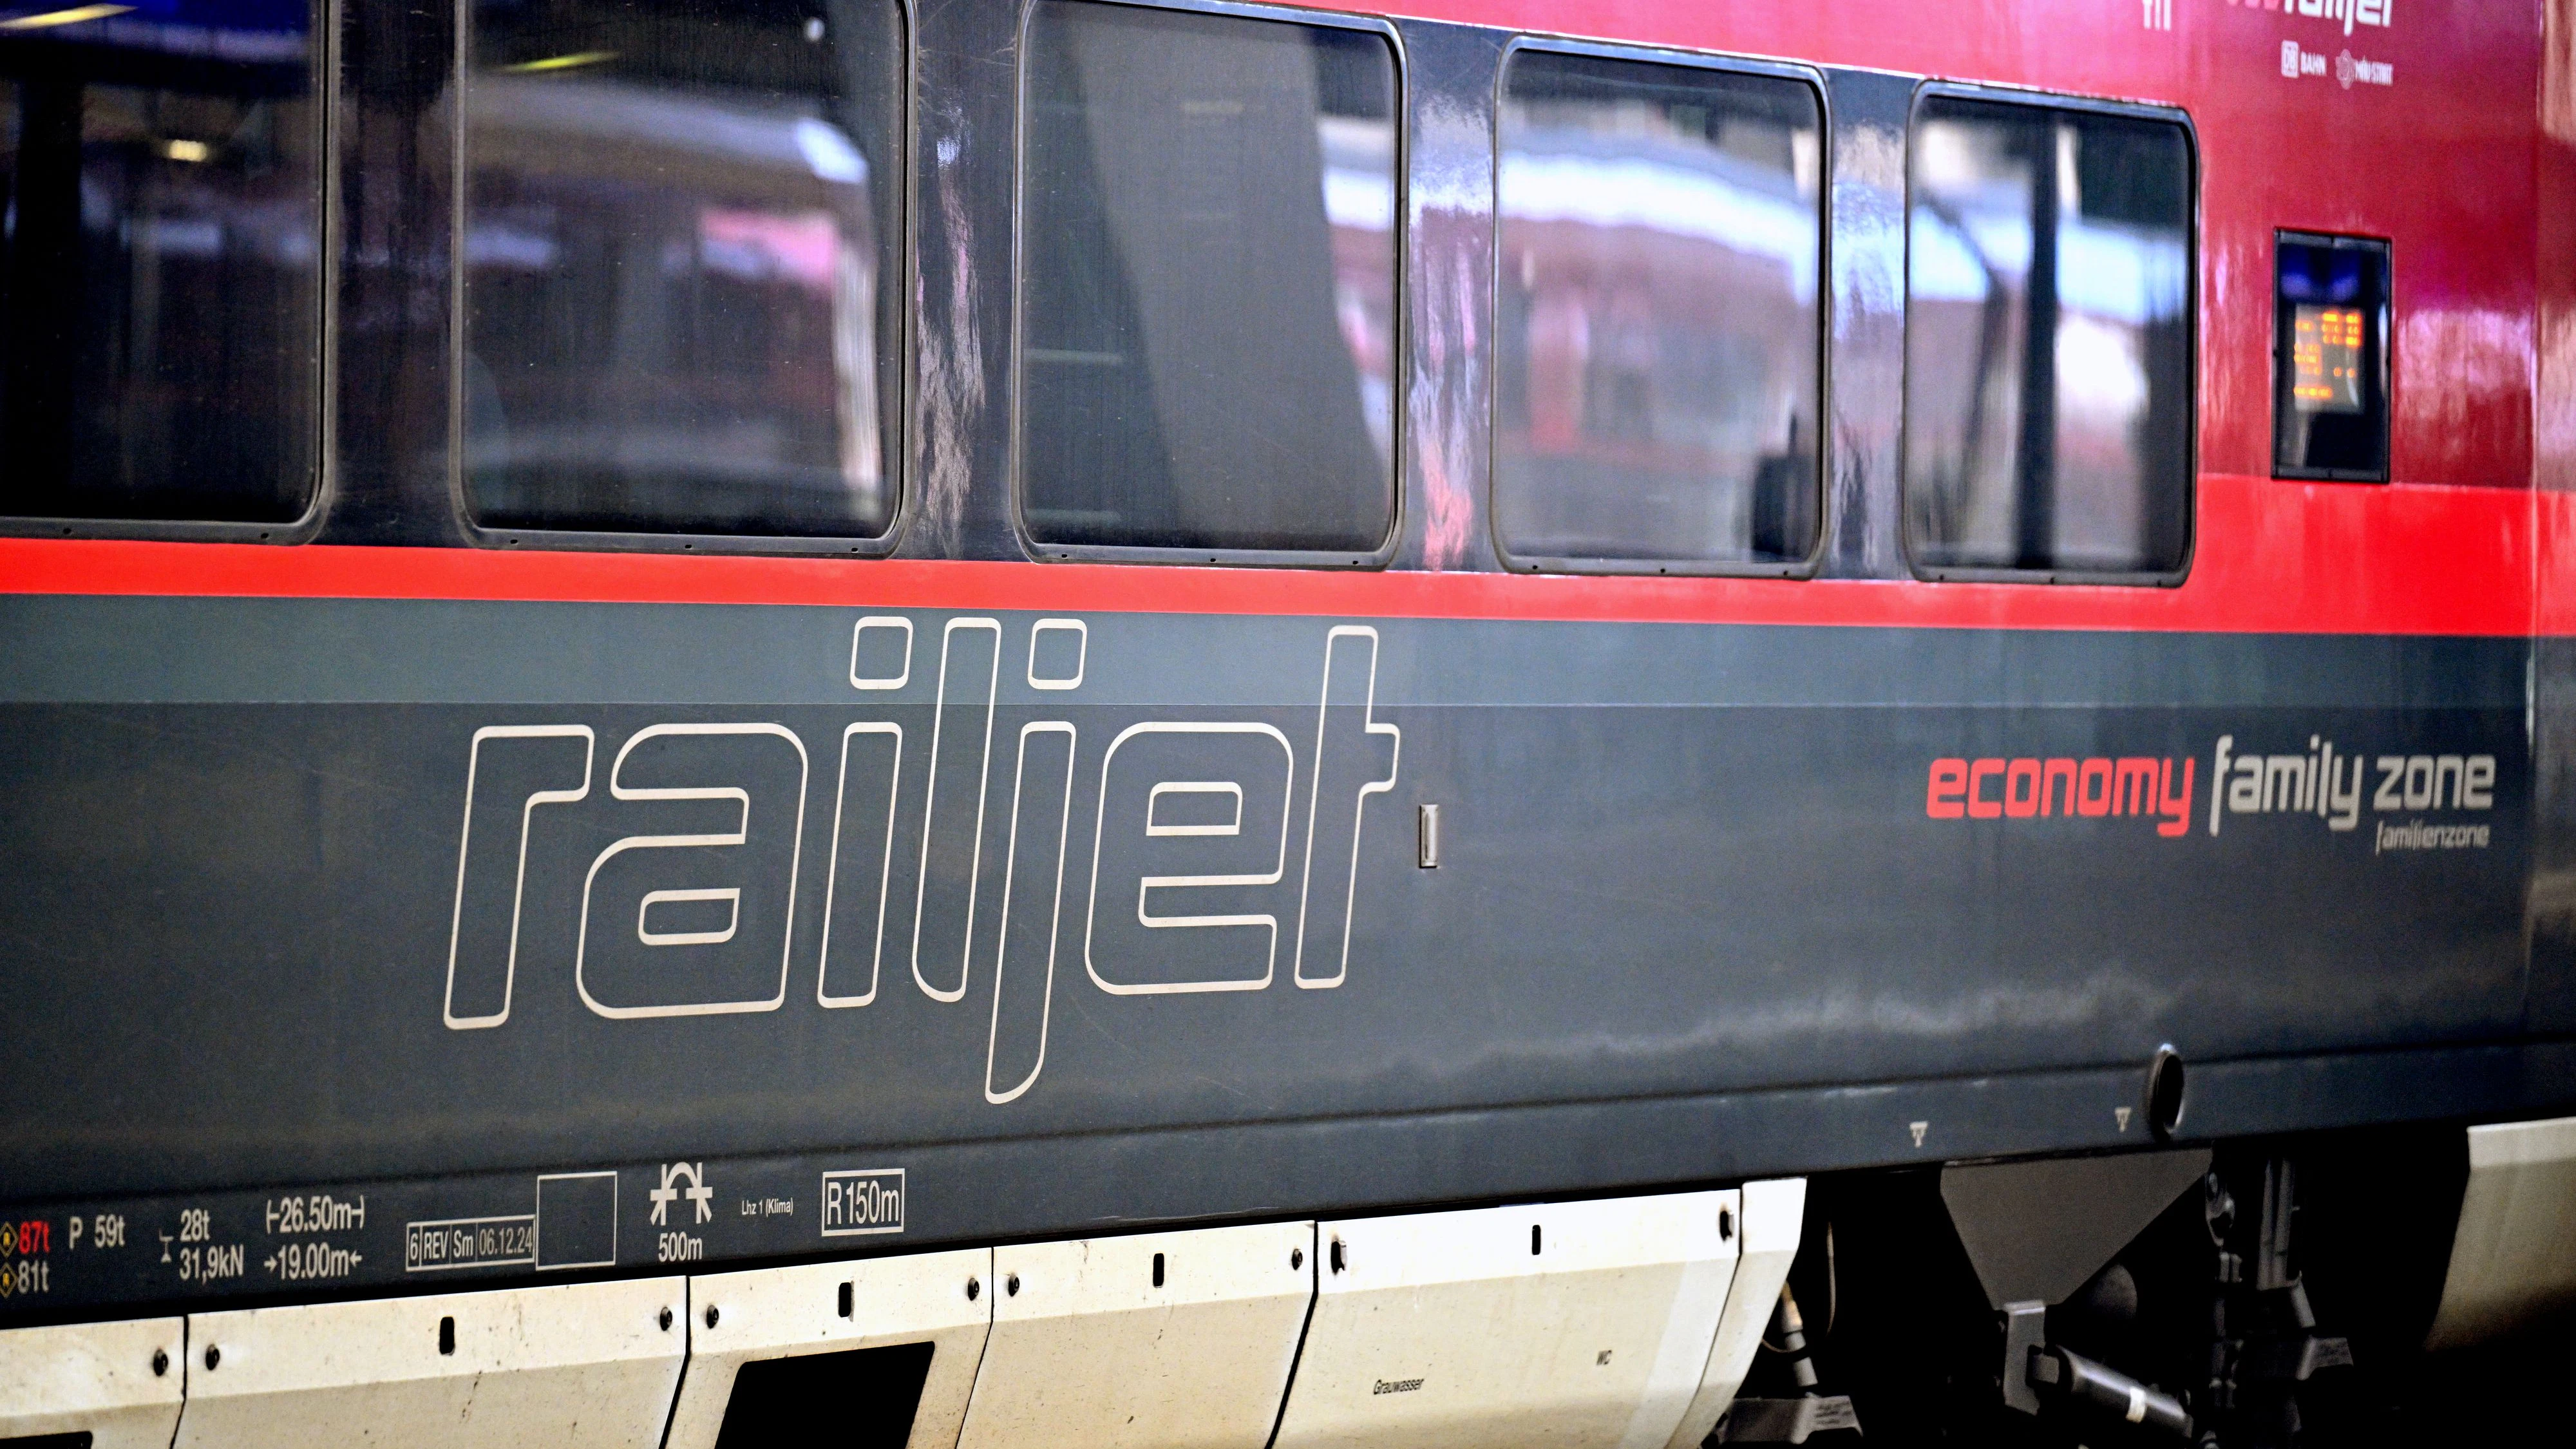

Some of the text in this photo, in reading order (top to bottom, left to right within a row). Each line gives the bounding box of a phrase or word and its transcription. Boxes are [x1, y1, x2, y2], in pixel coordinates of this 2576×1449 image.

[1926, 734, 2496, 837] economy family zone
[443, 616, 1400, 1104] railjet
[279, 1195, 351, 1233] 26.50m
[741, 1197, 793, 1217] Lhz 1 (Klima)
[19, 1220, 50, 1255] 87t
[69, 1214, 125, 1251] P 59t
[180, 1209, 210, 1243] 28t
[410, 1226, 533, 1260] 6 REV Sm 06.12.24
[278, 1242, 349, 1280] 19.00m
[659, 1231, 702, 1262] 500m
[18, 1260, 49, 1294] 81t
[180, 1244, 244, 1286] 31,9kN
[1373, 1378, 1425, 1395] Grauwasser
